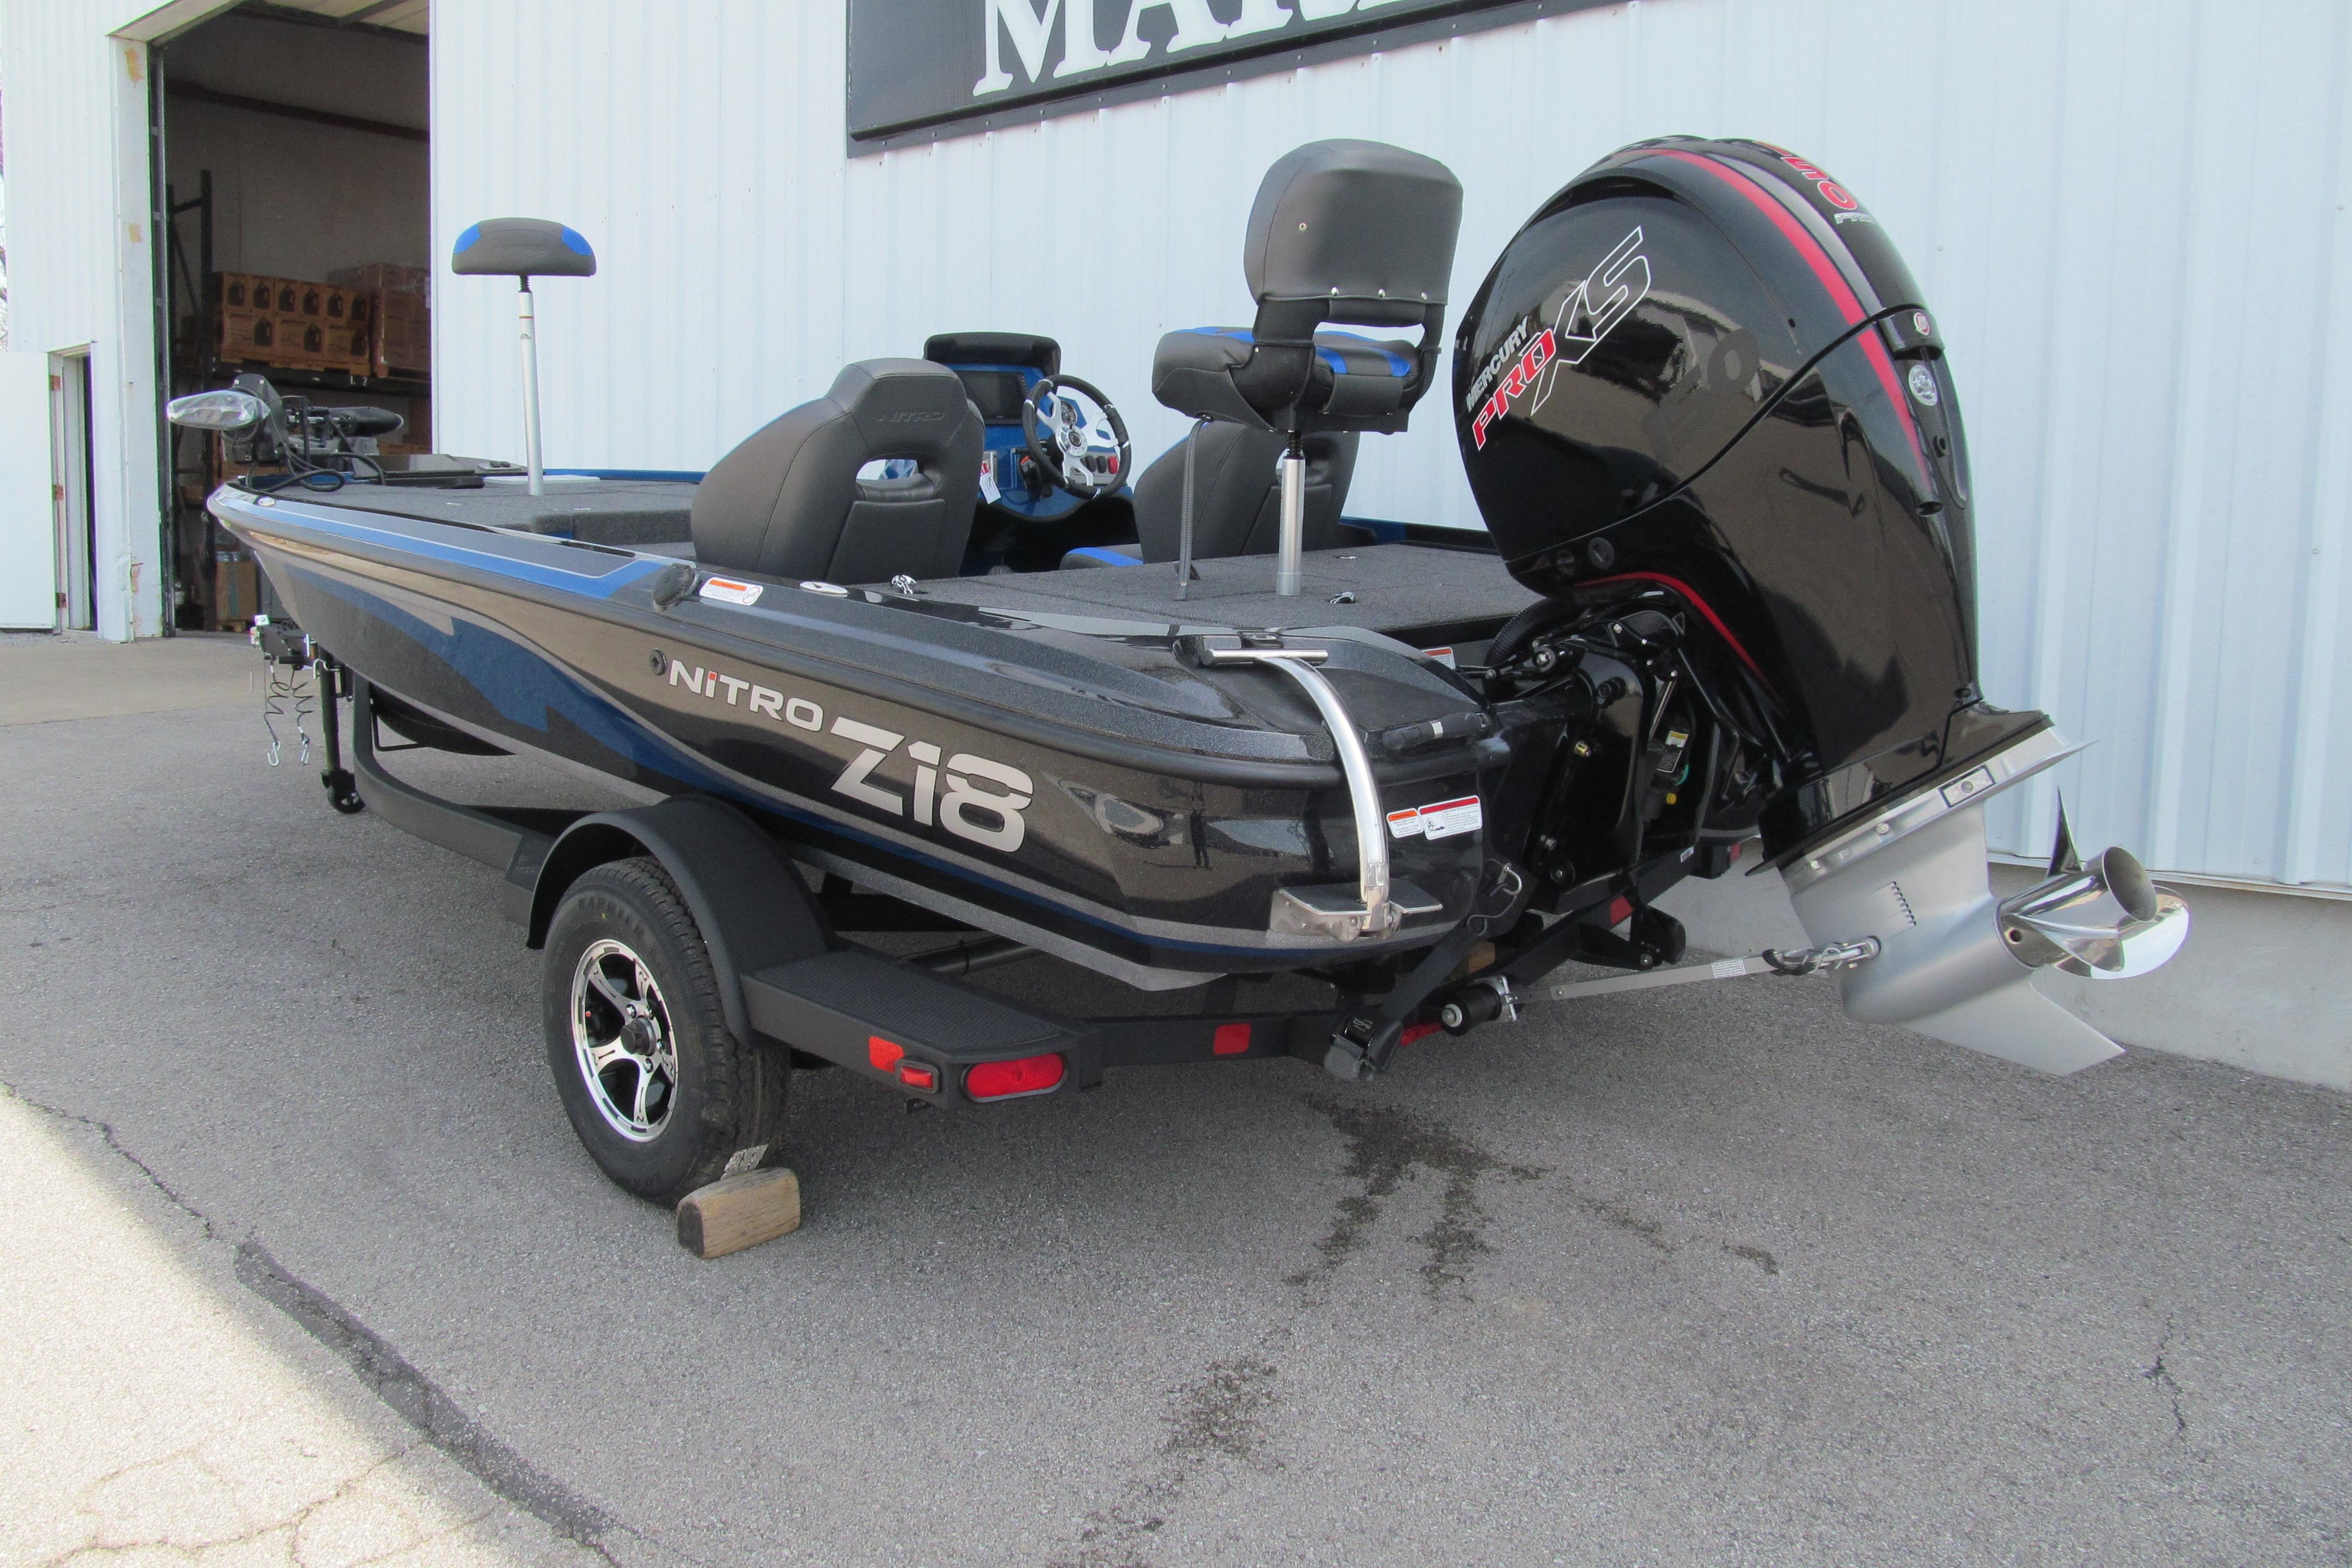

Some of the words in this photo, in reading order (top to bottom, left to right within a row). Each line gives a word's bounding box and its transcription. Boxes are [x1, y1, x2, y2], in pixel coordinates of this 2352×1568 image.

[1466, 315, 1528, 413] MERCURY
[1472, 328, 1557, 451] PRO
[1517, 225, 1651, 417] XS
[830, 716, 1034, 853] Z18
